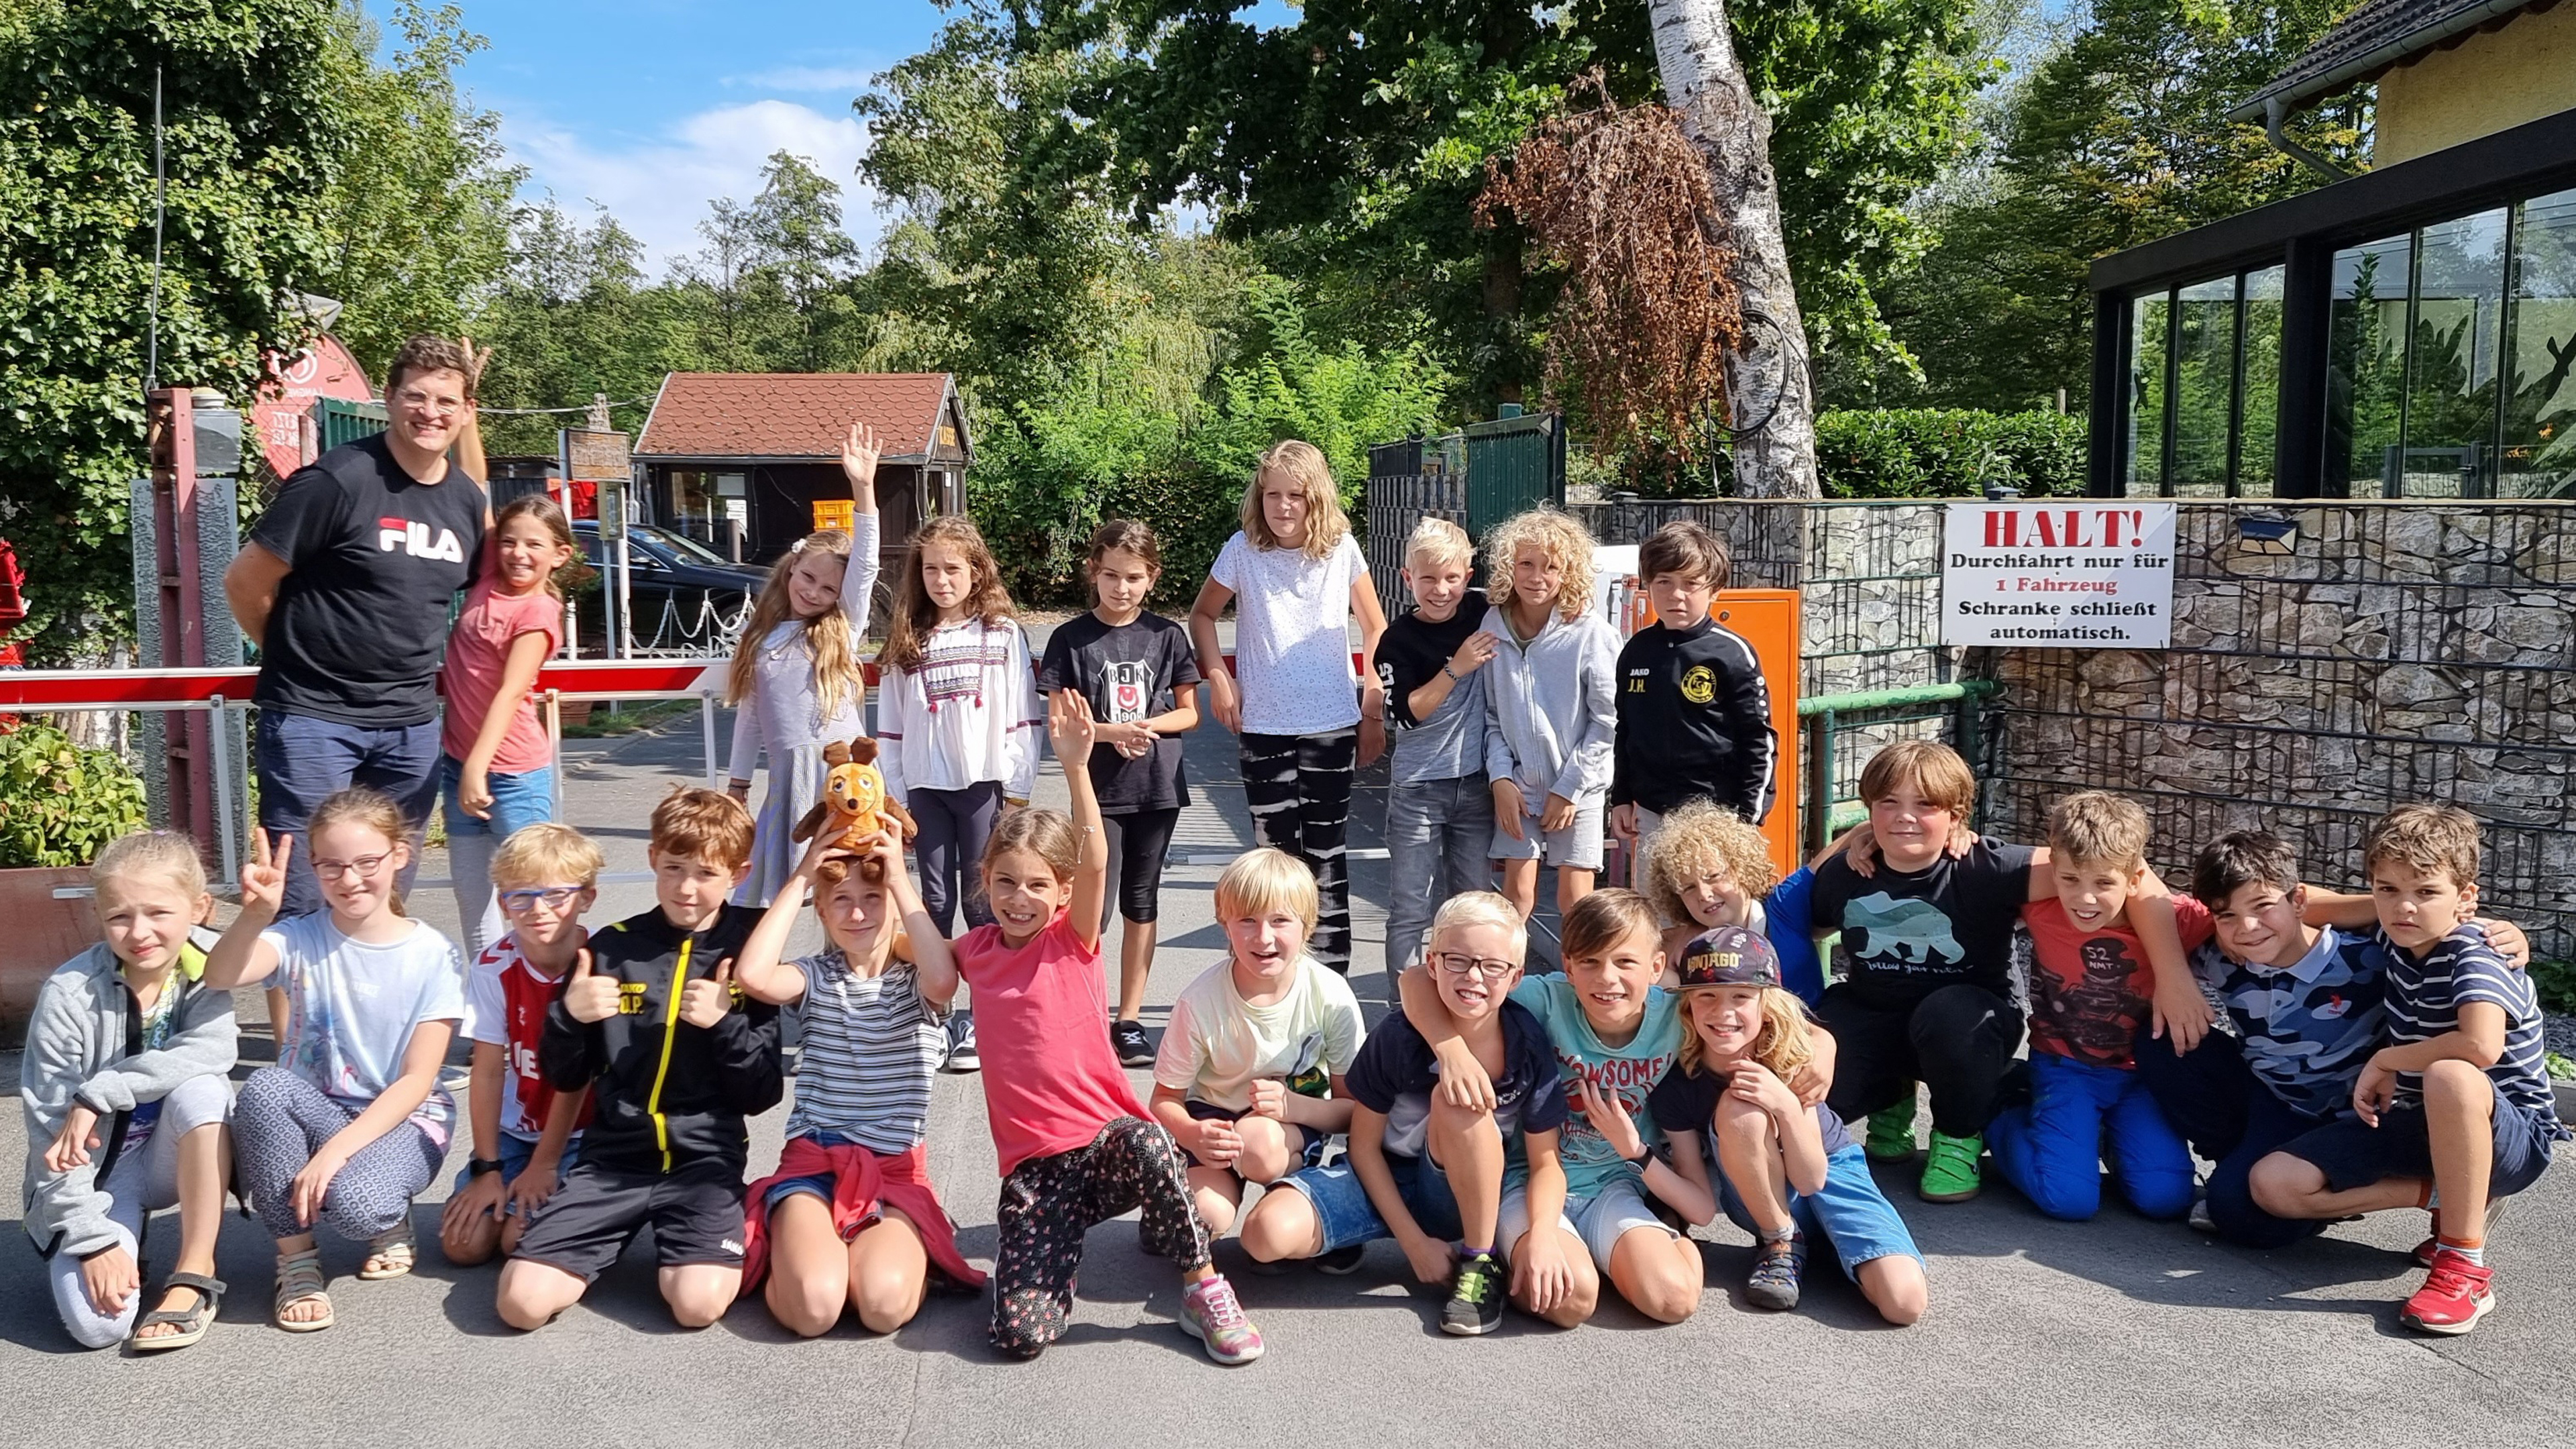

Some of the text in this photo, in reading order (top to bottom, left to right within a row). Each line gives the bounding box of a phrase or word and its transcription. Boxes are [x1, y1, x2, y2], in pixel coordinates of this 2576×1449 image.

[1981, 510, 2144, 548] HALT!
[379, 517, 464, 564] FILA
[1951, 553, 2169, 568] Durchfahrt nur für
[1996, 578, 2118, 596] 1 Fahrzeug
[1959, 601, 2157, 616] Schranke schließt
[1990, 626, 2131, 641] automatisch.
[1629, 668, 1650, 676] JAKO
[1627, 679, 1646, 692] J.H.
[2086, 947, 2110, 961] 52
